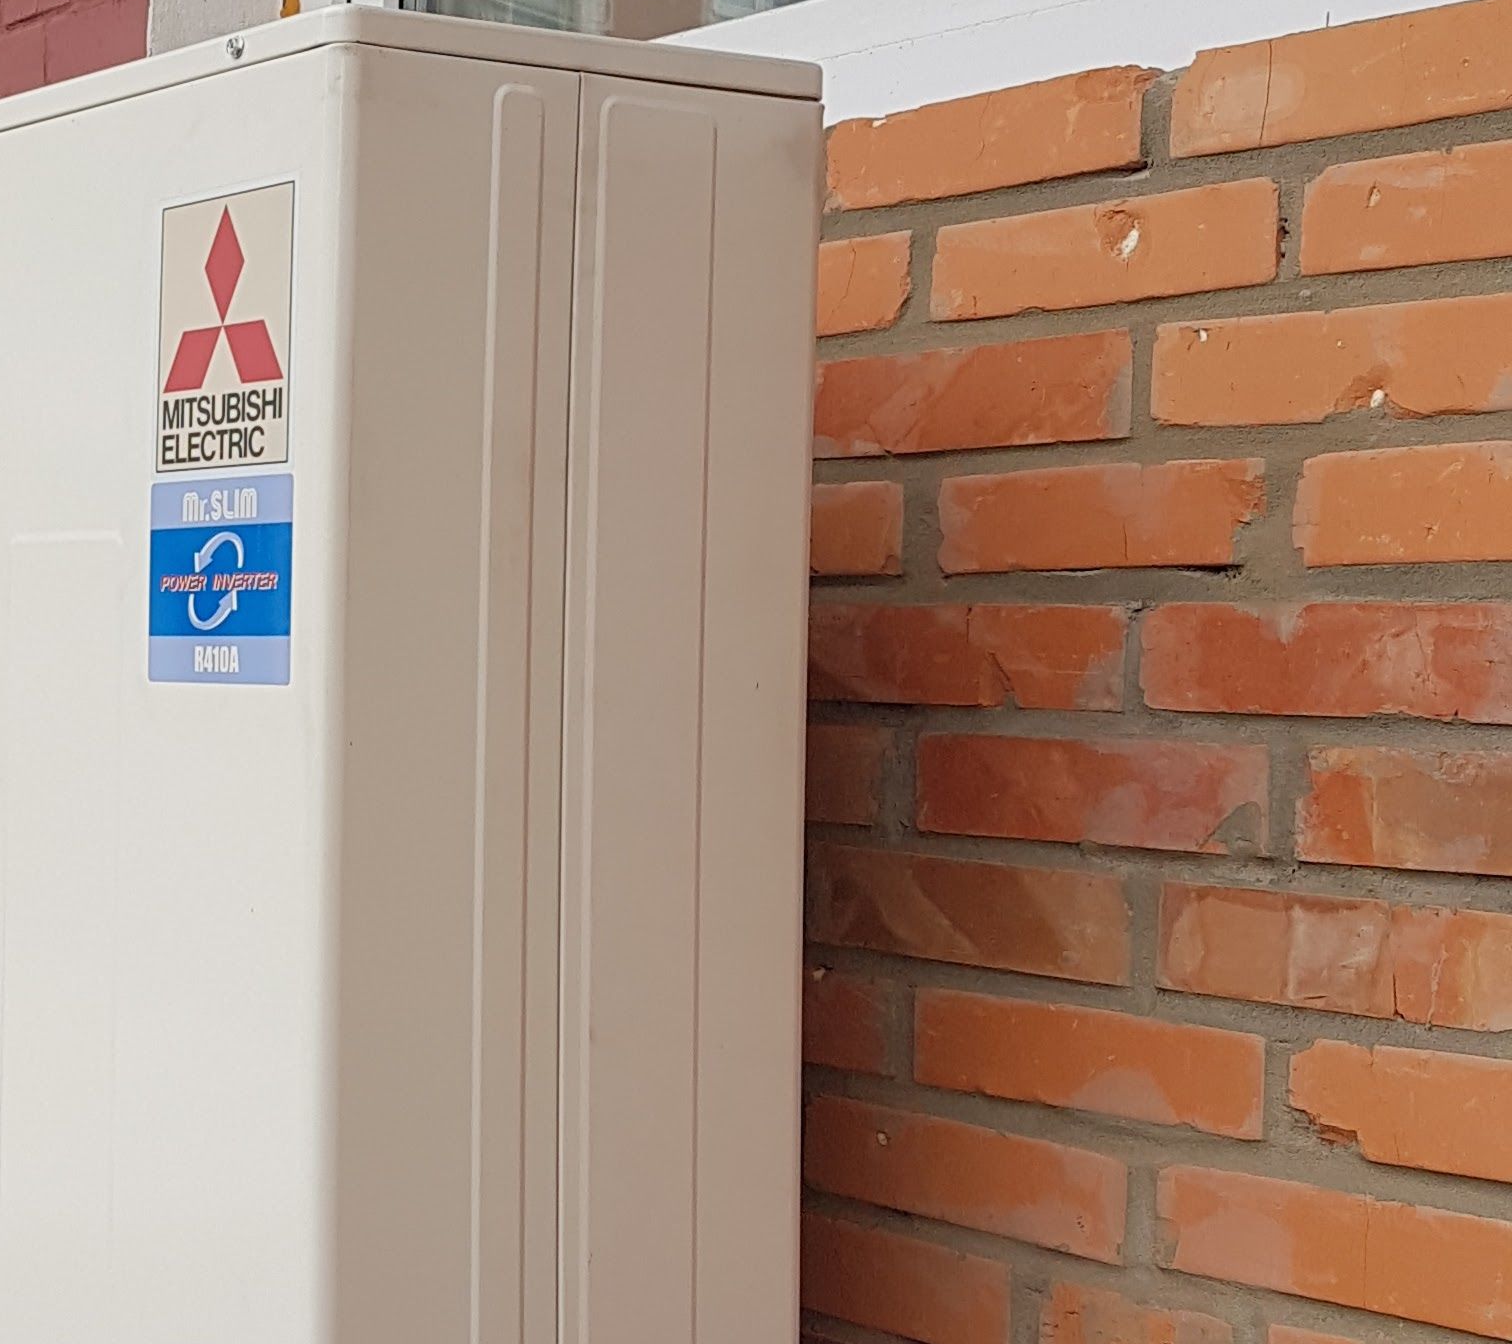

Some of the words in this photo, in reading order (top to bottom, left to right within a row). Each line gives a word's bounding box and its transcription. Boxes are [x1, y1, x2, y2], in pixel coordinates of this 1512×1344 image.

[162, 387, 283, 430] MITSUBISHI
[161, 425, 265, 465] ELECTRIC
[160, 573, 208, 593] POWER
[212, 572, 279, 592] INVERTER
[194, 645, 240, 674] R410A
